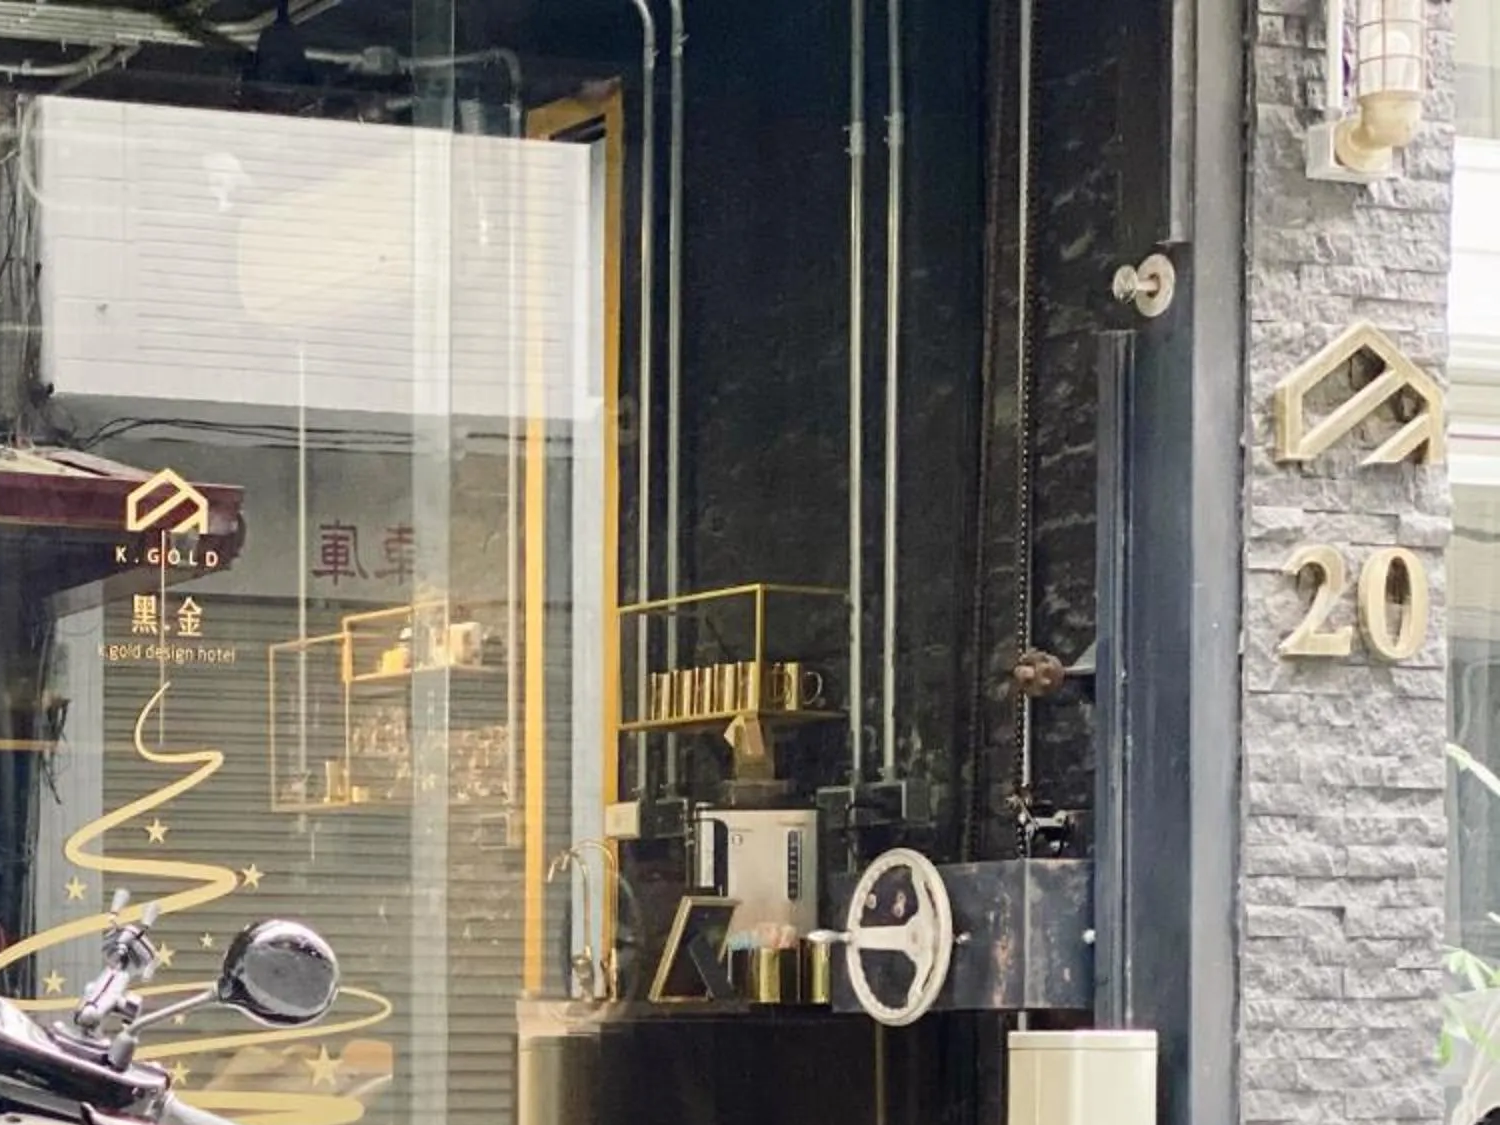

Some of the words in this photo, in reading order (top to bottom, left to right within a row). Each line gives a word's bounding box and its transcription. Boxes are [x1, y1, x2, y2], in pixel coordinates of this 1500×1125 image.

[115, 545, 219, 568] K.GOLD
[1278, 544, 1430, 660] 20
[145, 643, 194, 665] design
[197, 644, 236, 663] hotel
